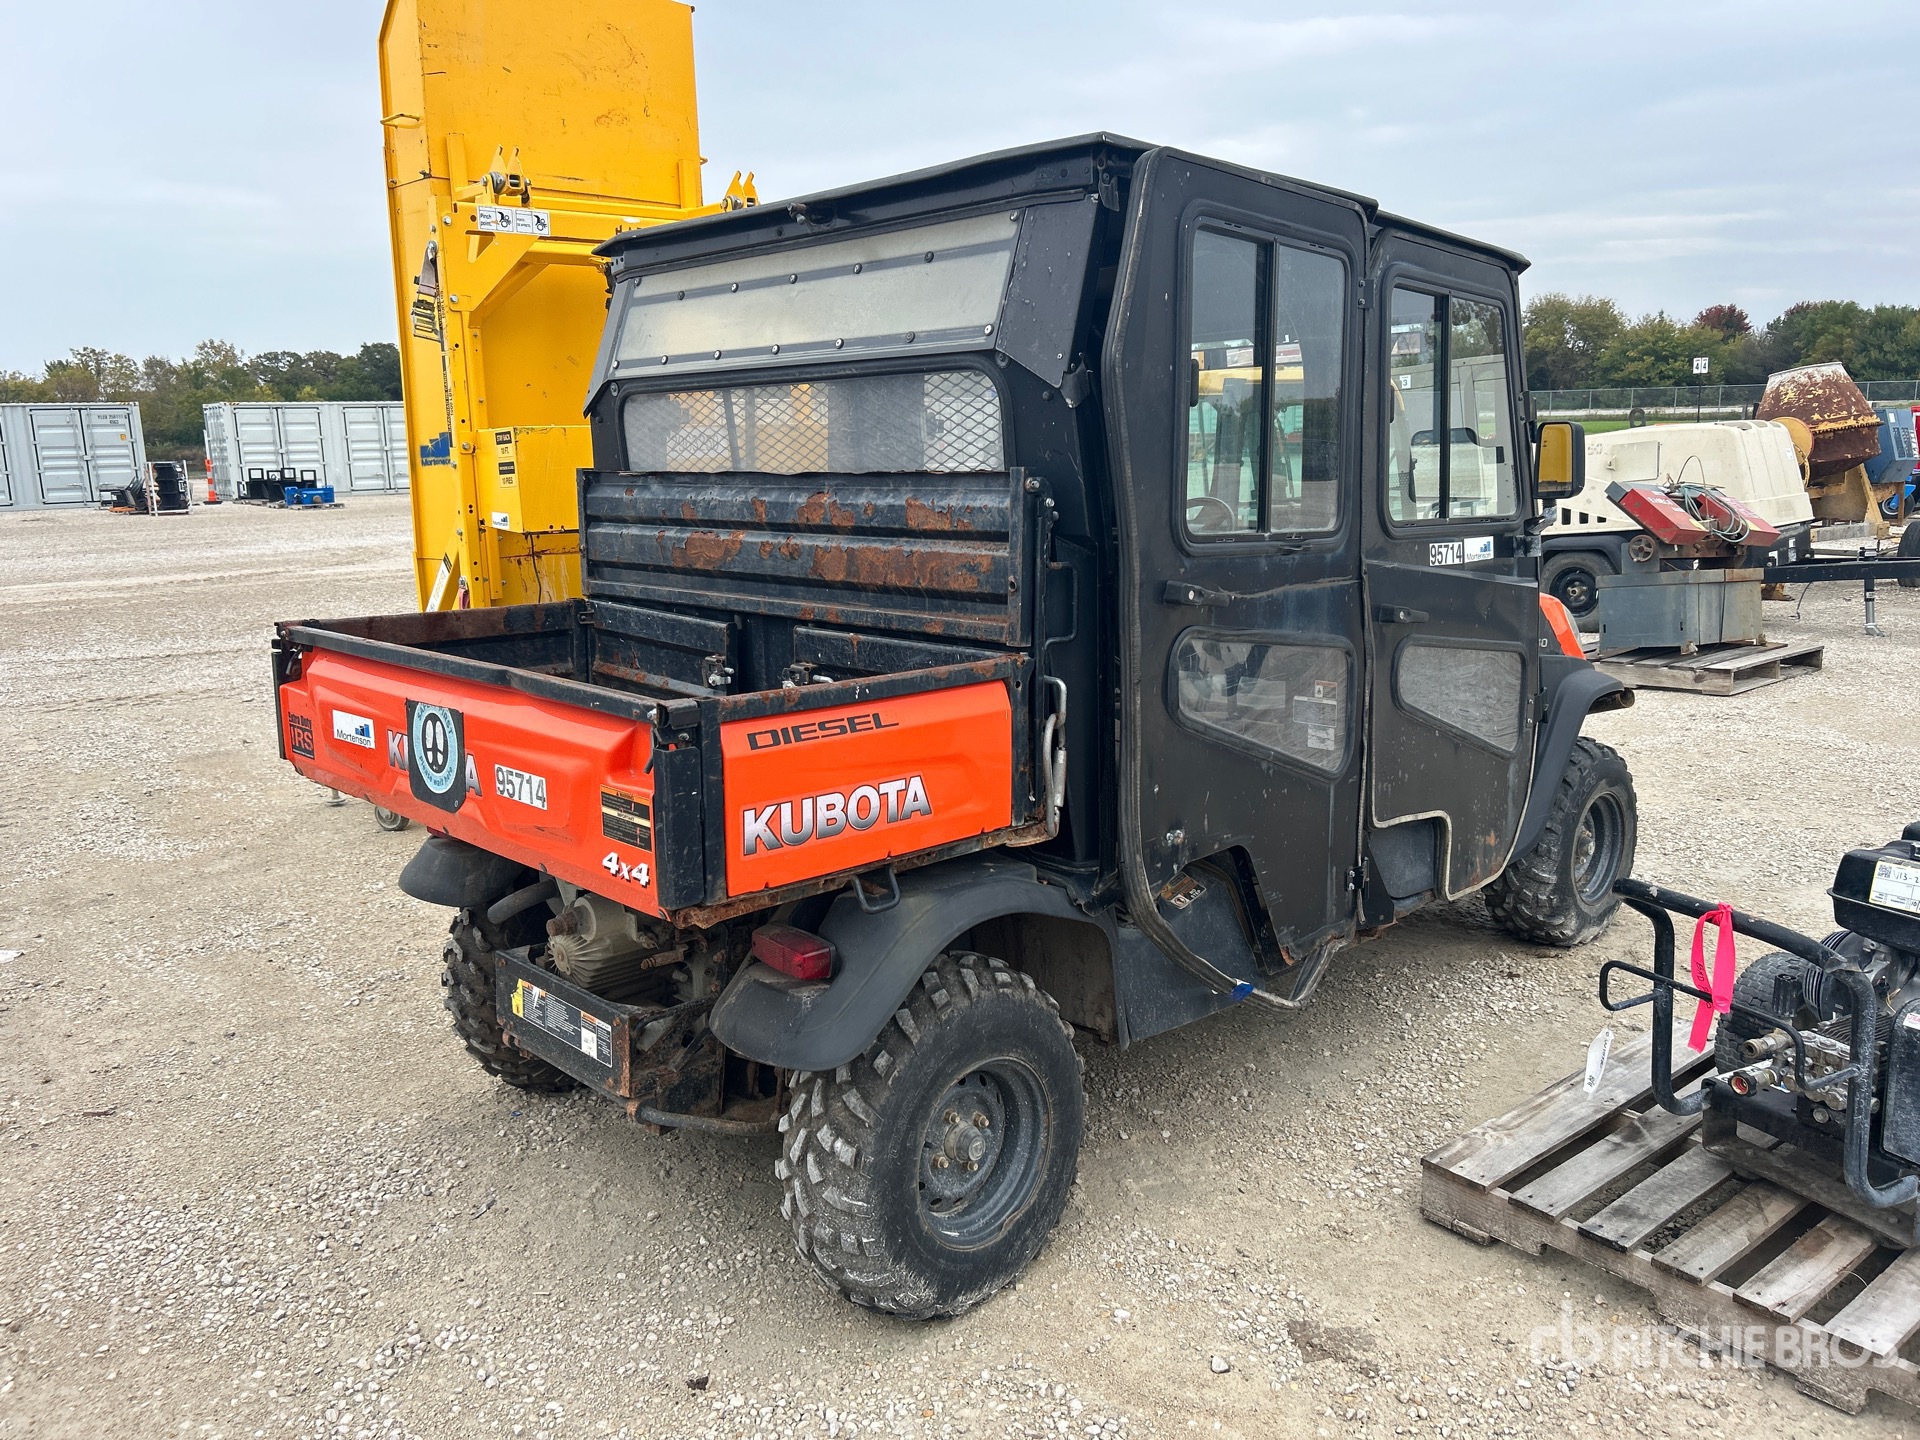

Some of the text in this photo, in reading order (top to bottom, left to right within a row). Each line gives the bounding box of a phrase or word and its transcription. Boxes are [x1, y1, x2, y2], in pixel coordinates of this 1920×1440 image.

[1430, 544, 1463, 565] 95714
[290, 726, 314, 751] IRS
[336, 728, 372, 747] Mortenson
[747, 712, 899, 751] DIESEL
[495, 766, 546, 809] 95714
[743, 775, 932, 857] KUBOTA
[602, 851, 651, 889] 4x4
